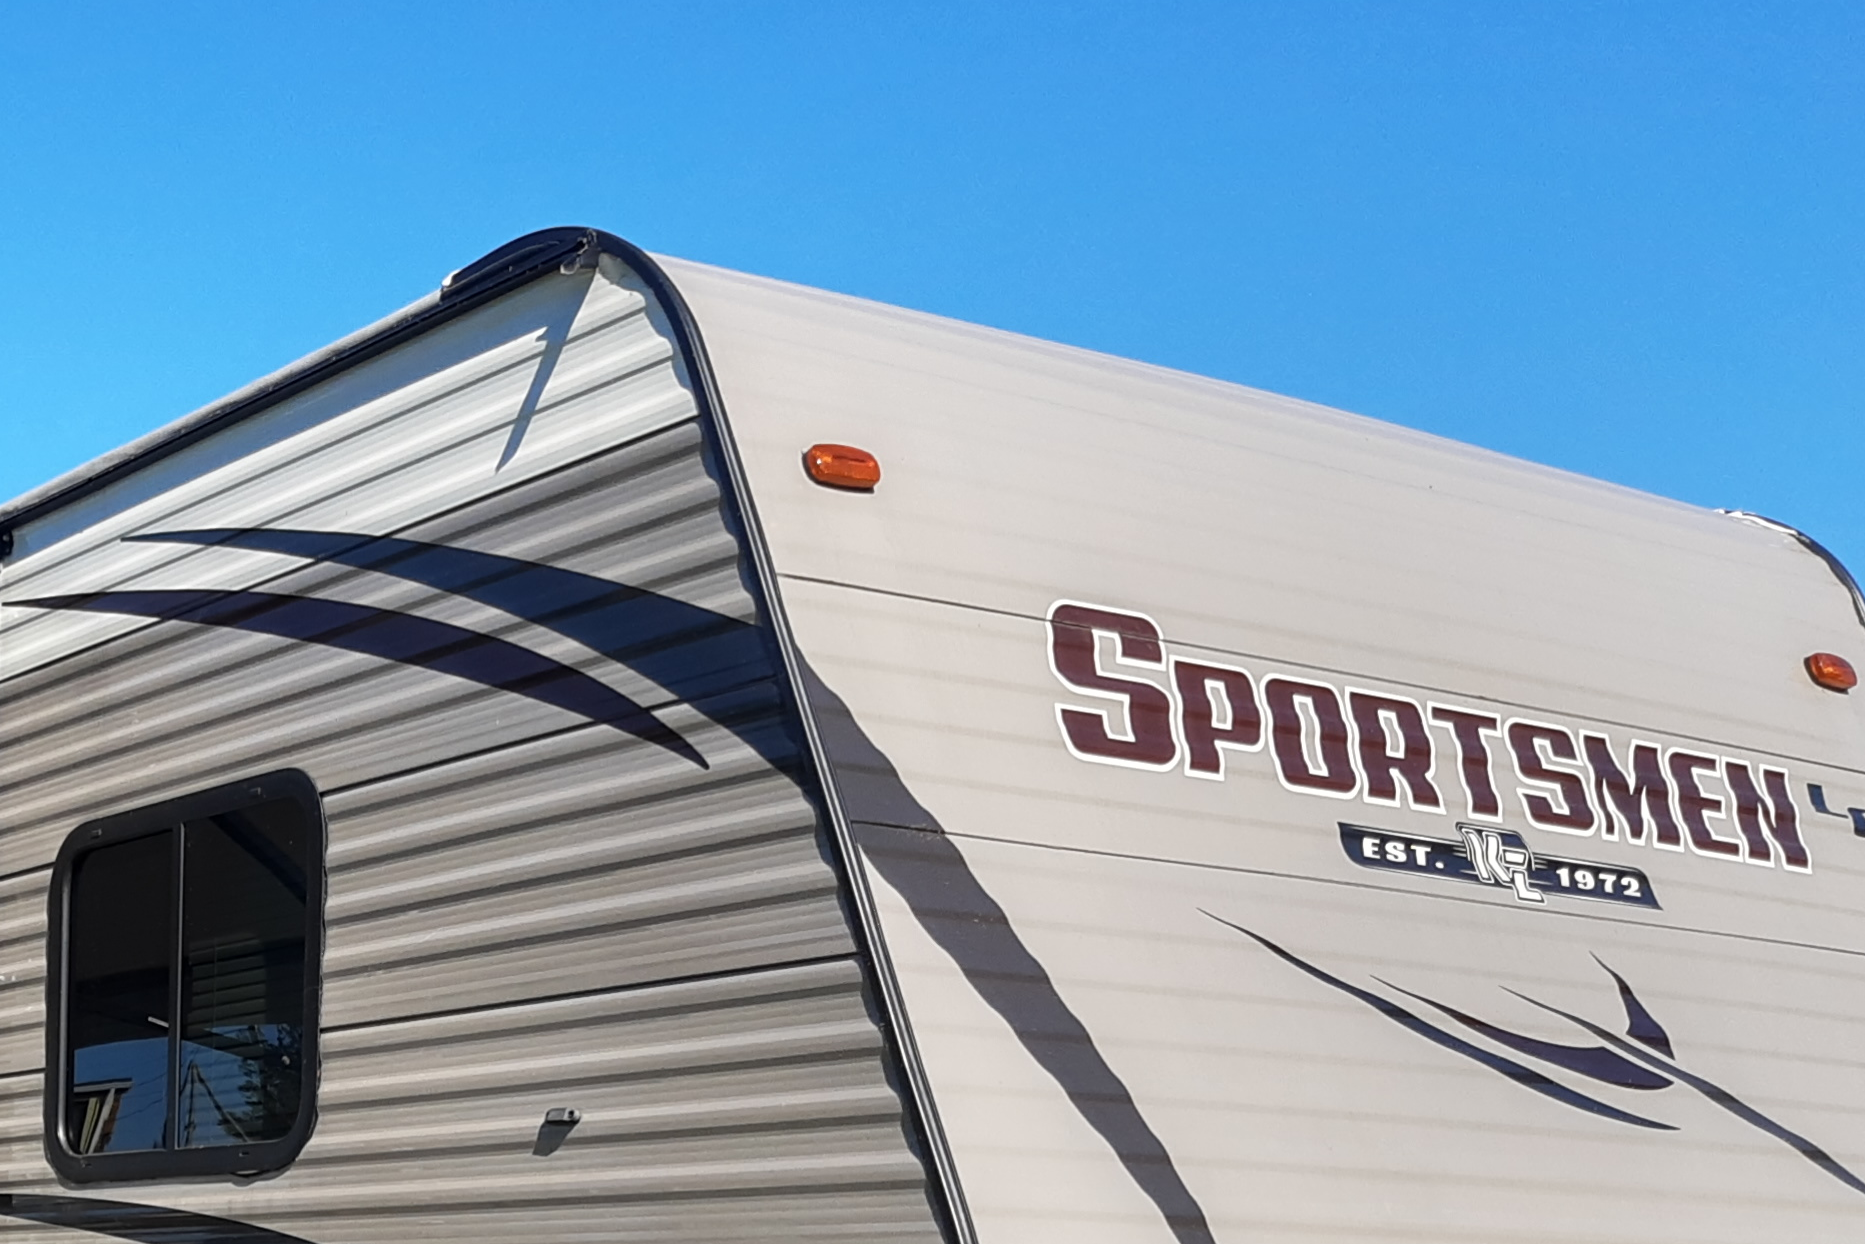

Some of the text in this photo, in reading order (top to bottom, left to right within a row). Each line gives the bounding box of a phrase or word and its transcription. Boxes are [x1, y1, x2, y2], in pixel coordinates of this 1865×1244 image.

[1046, 599, 1812, 874] SPORTSMEN
[1362, 837, 1444, 869] EST.
[1556, 867, 1641, 898] 1972
